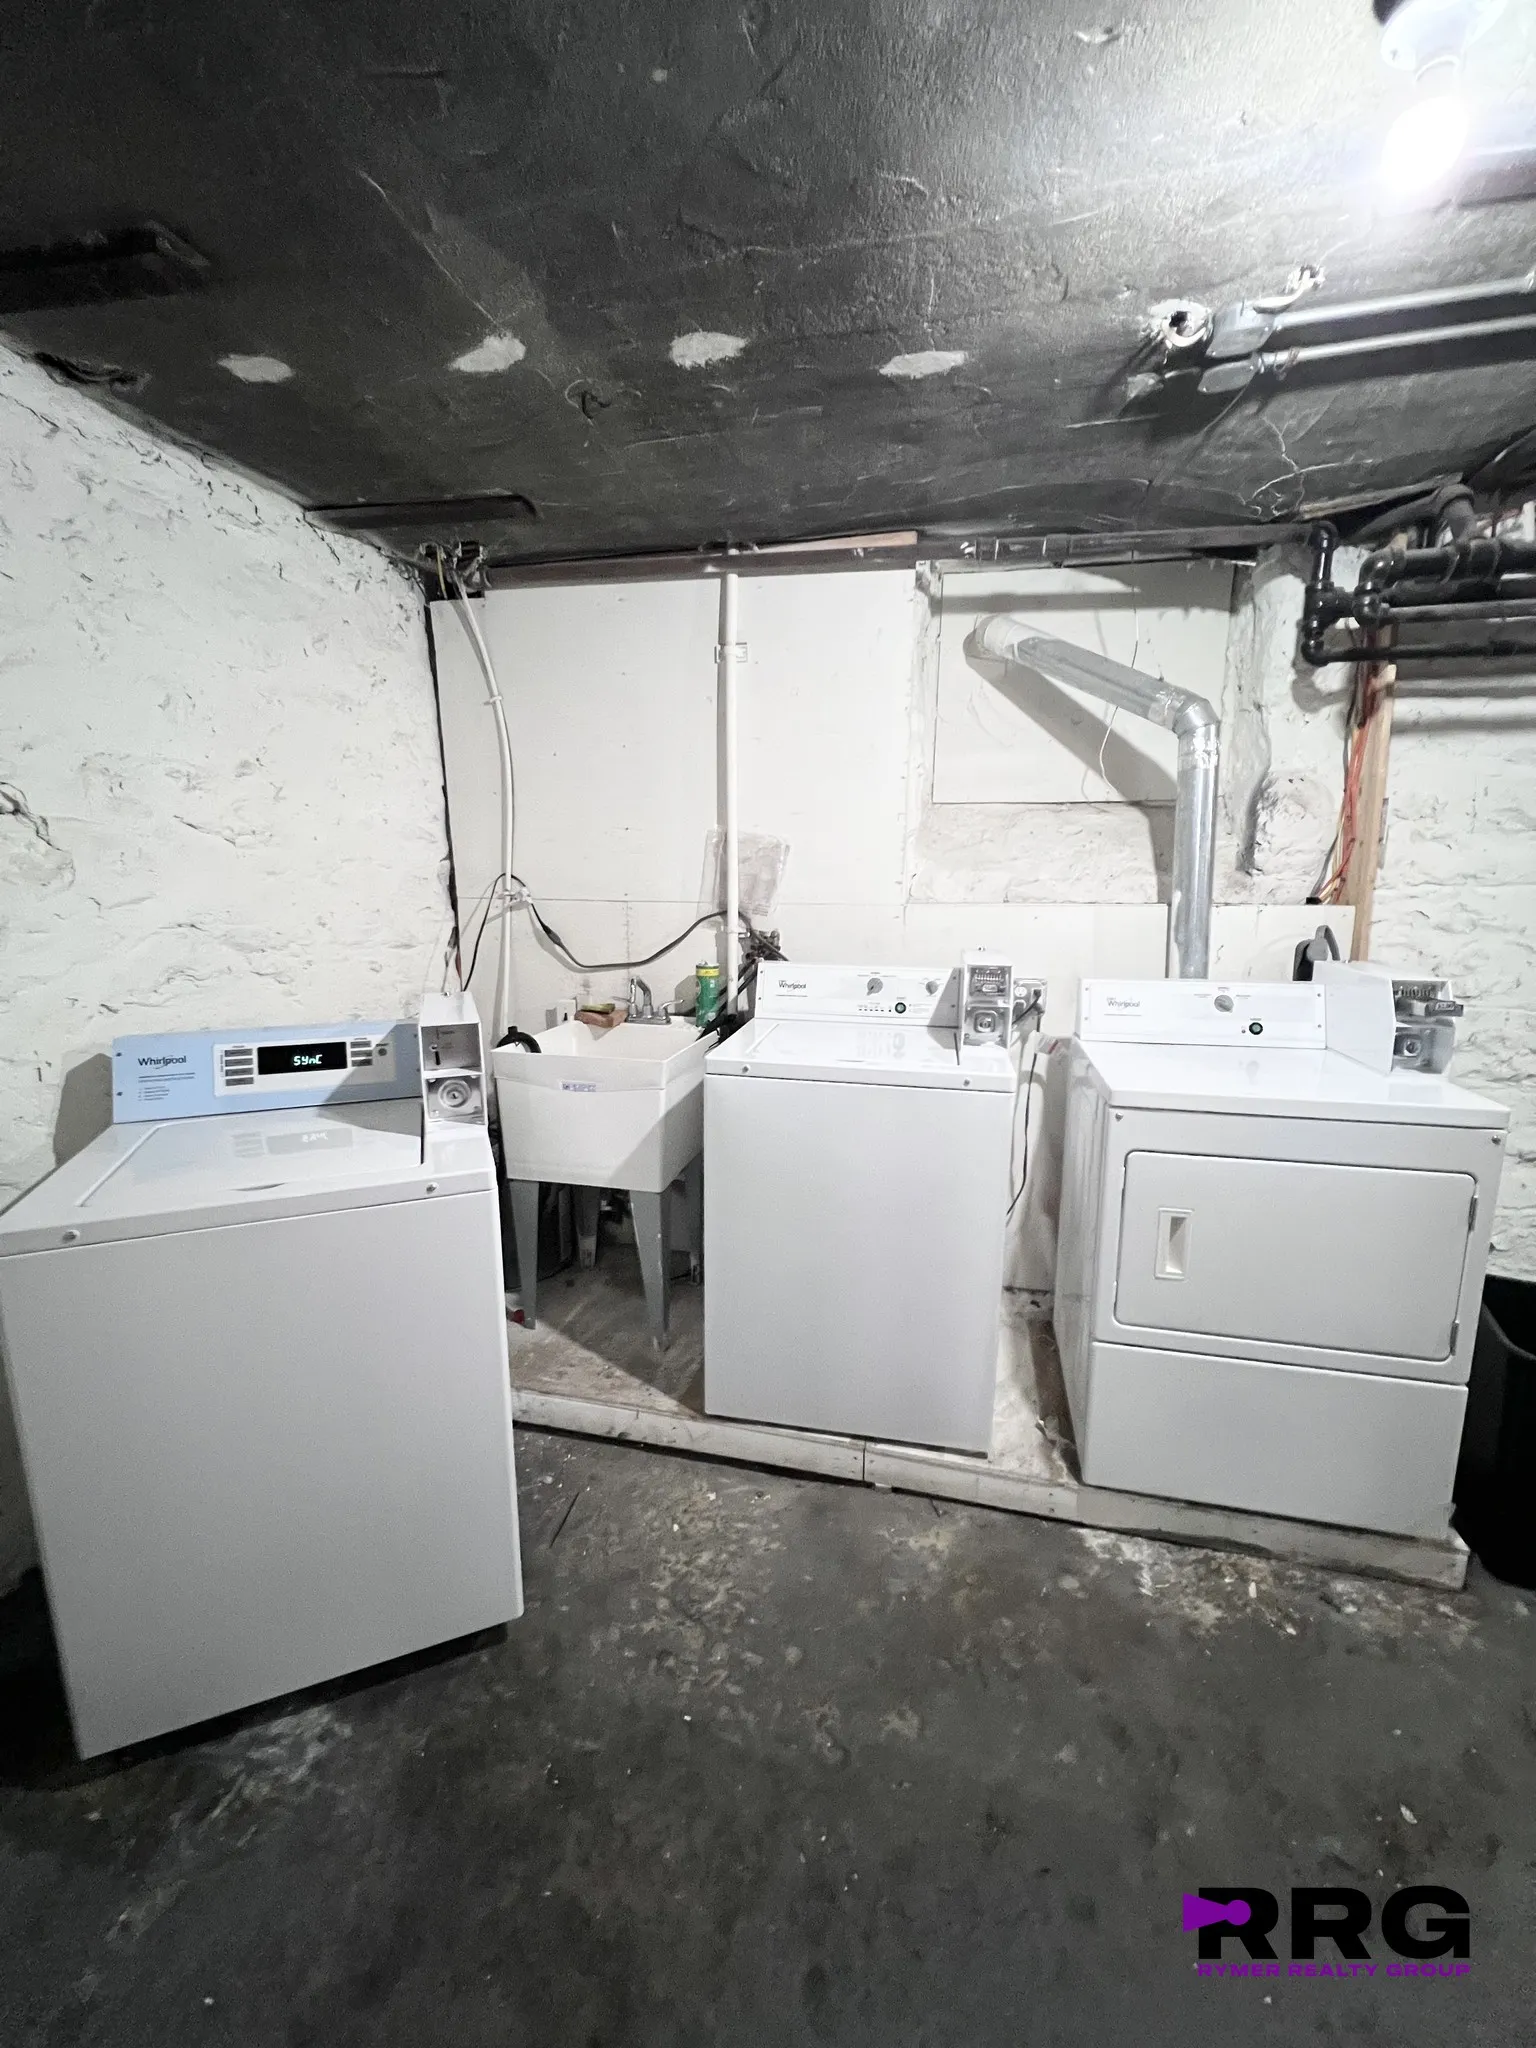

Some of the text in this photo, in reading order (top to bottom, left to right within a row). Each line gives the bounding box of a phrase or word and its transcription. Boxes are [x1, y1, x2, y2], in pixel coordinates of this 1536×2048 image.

[778, 979, 807, 990] Whirlpool
[1107, 999, 1140, 1009] Whirlpool
[137, 1055, 187, 1068] Whirlpool
